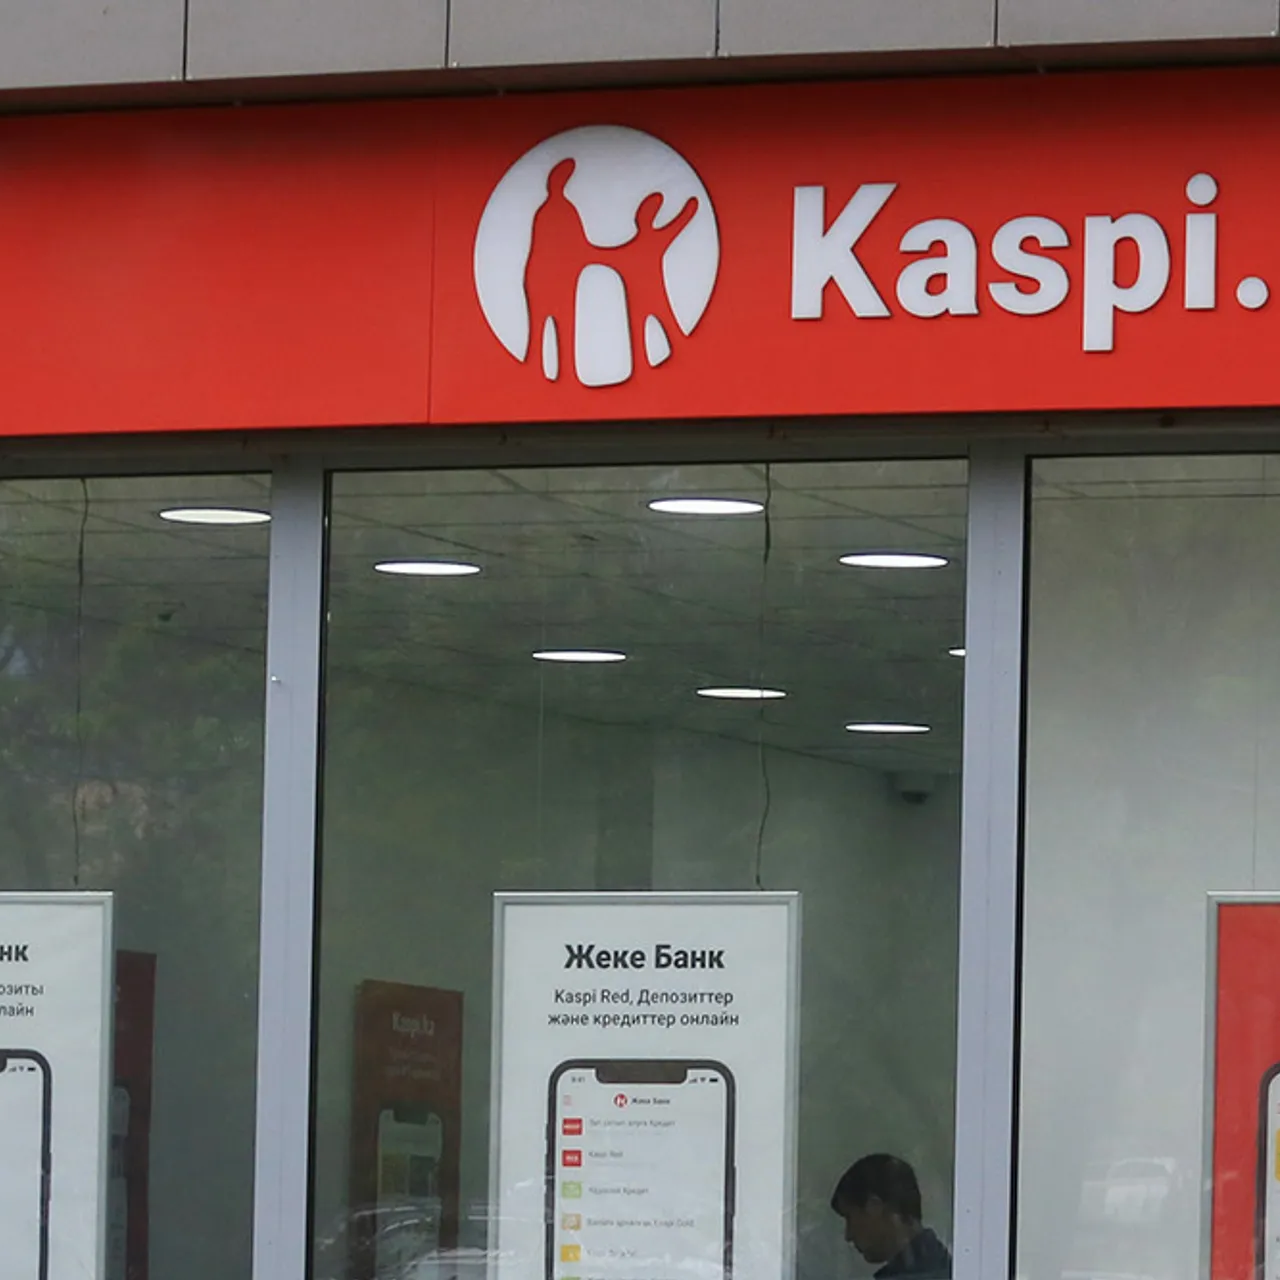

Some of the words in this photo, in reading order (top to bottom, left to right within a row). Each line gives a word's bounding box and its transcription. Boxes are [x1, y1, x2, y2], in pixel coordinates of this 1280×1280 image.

[563, 944, 646, 969] Жеке
[654, 944, 725, 969] Банк
[554, 989, 597, 1007] Kaspi
[600, 989, 634, 1006] Red,
[637, 989, 734, 1007] Депозиттер
[548, 1013, 590, 1026] және
[593, 1013, 676, 1029] кредиттер
[680, 1011, 740, 1026] онлайн
